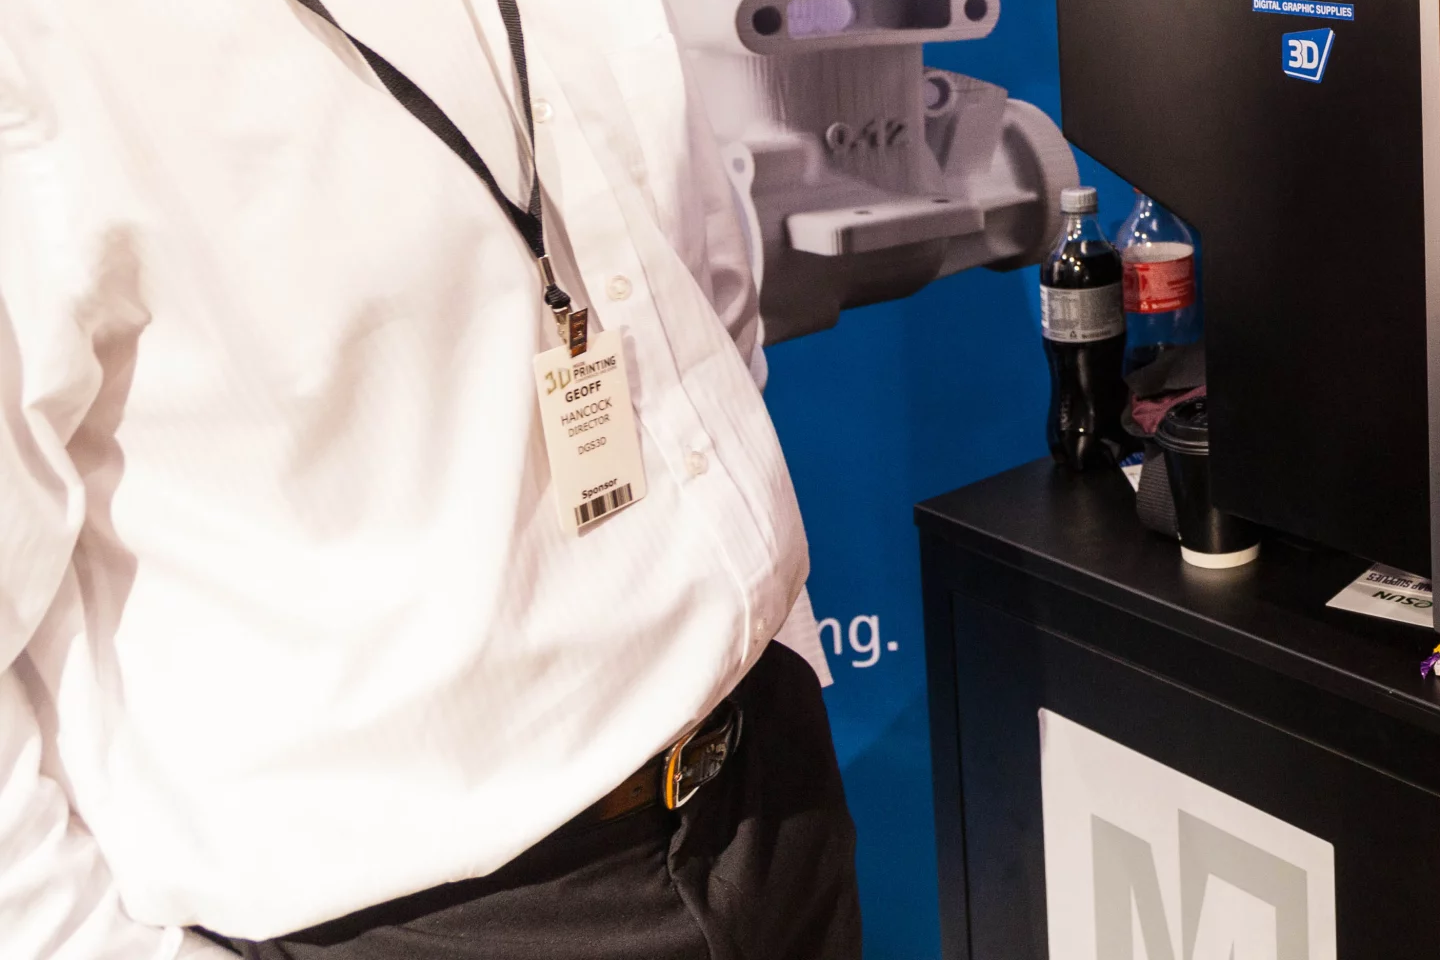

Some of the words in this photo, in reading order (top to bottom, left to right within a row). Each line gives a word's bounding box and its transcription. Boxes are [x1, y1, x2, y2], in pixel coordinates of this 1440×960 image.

[1282, 1, 1315, 14] GRAPHIC
[1315, 4, 1353, 18] SUPPLIES
[1288, 39, 1319, 70] 3D
[573, 355, 617, 380] PRINTING
[565, 380, 602, 403] GEOFF
[561, 396, 613, 427] HANCOCK
[568, 413, 611, 438] DIRECTOR
[577, 436, 608, 456] DGS3D
[581, 478, 618, 501] Sponsor
[1366, 573, 1413, 587] SUPPLIES
